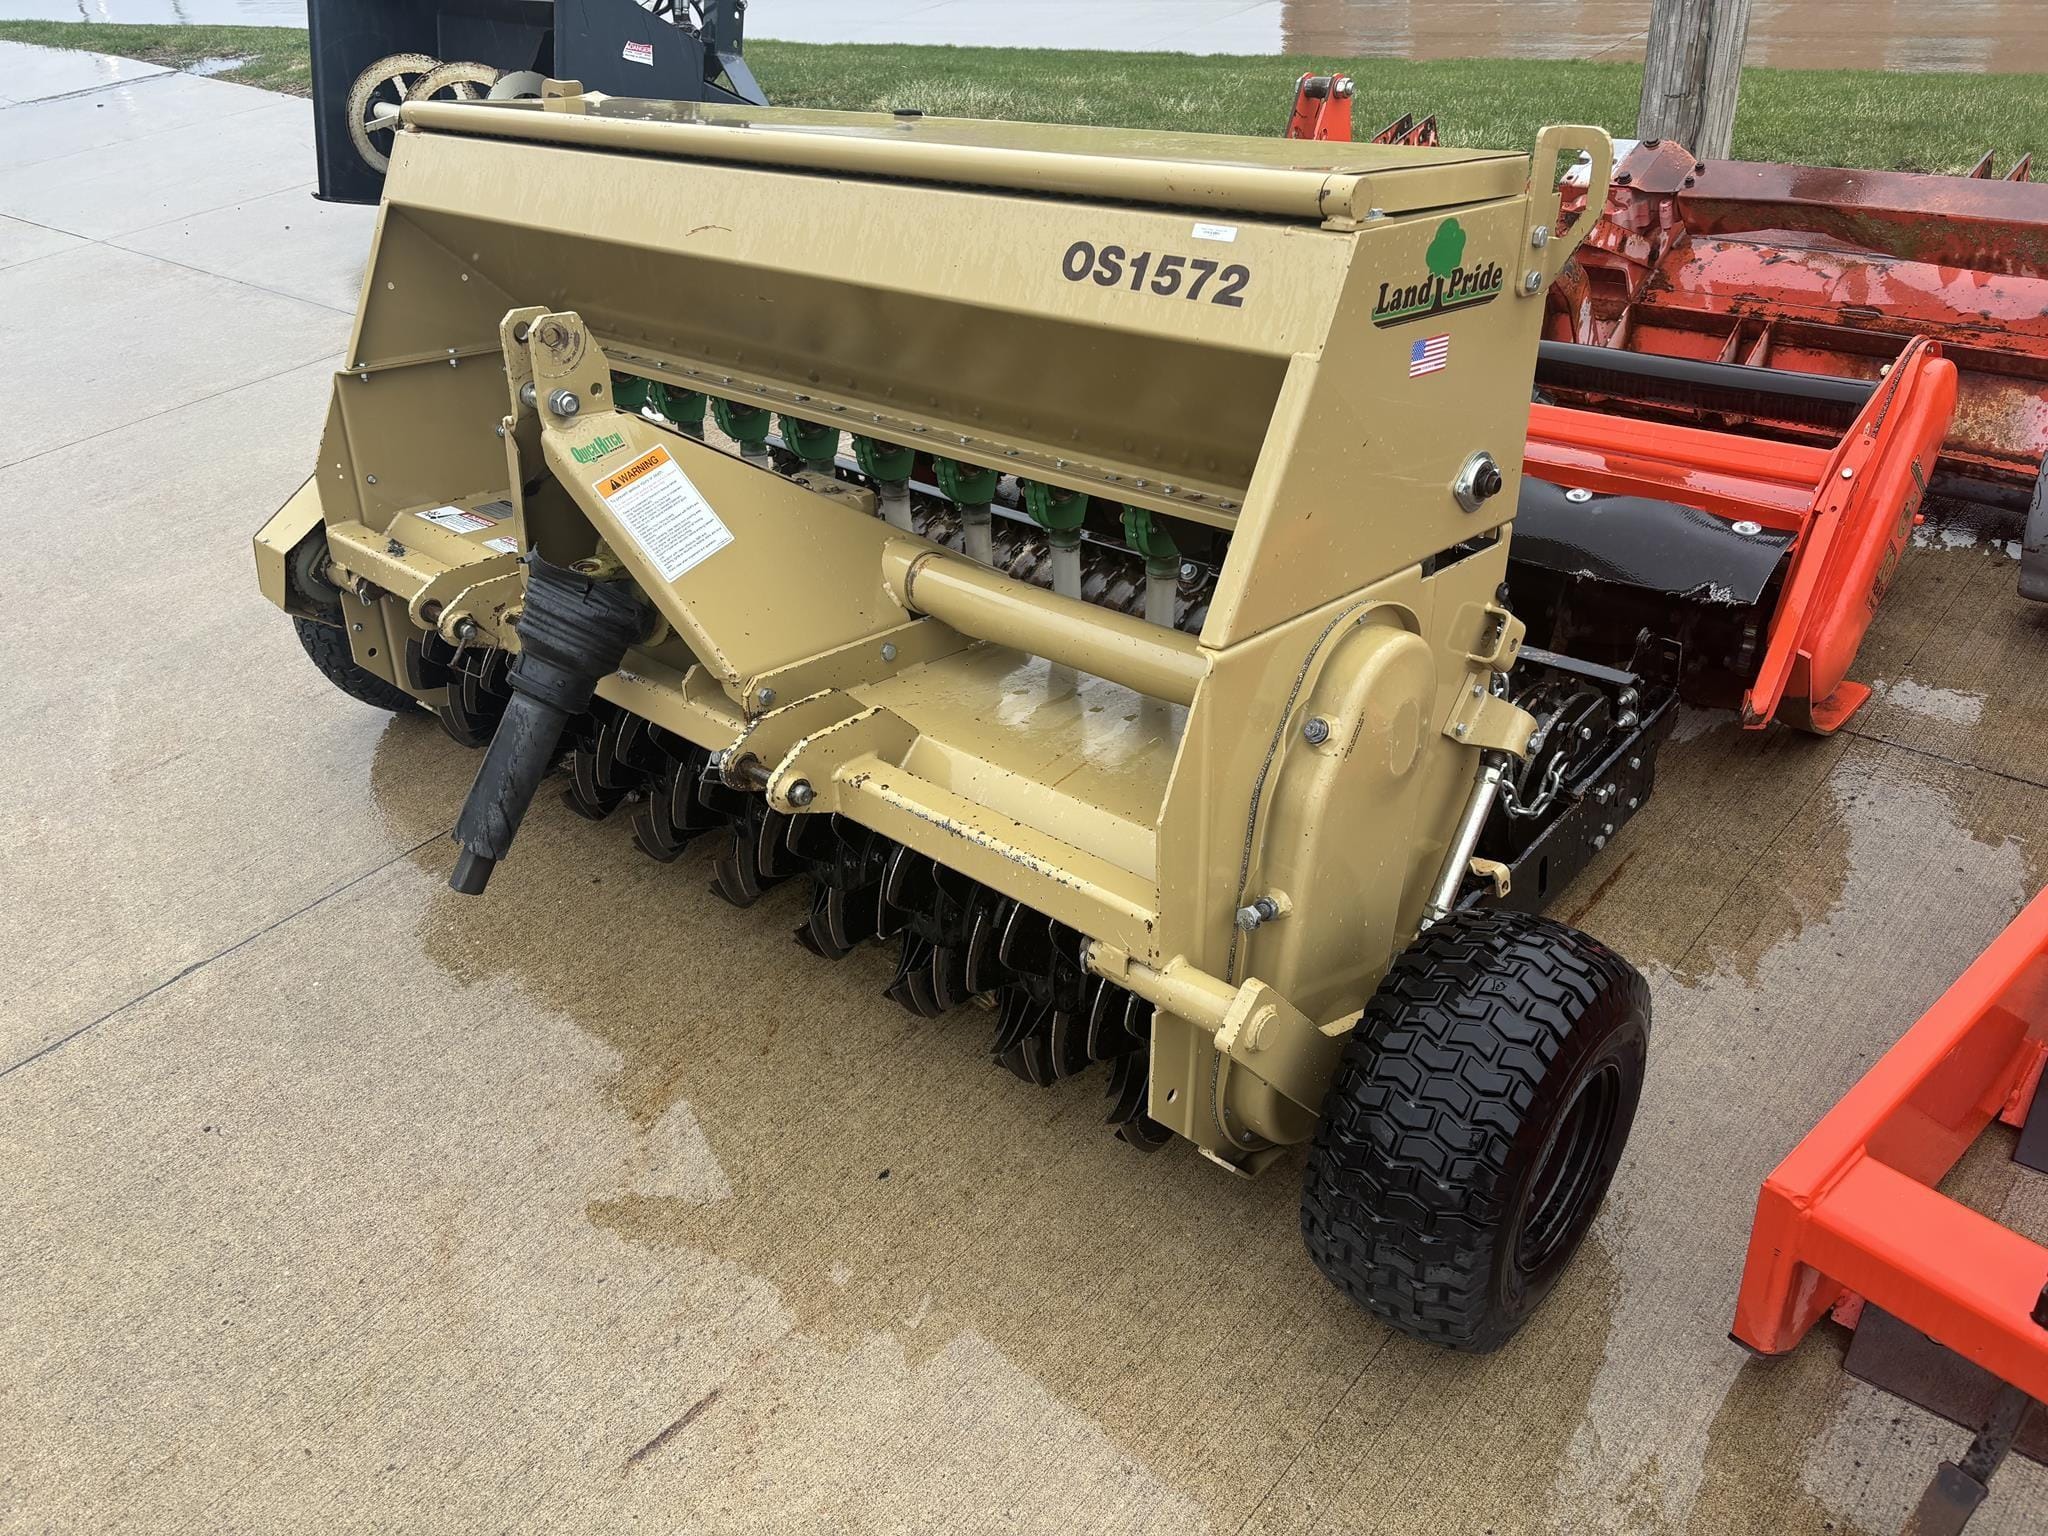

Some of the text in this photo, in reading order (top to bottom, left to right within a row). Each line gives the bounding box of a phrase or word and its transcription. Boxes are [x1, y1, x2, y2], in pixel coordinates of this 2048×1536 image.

[1062, 240, 1250, 308] OS1572
[1375, 261, 1503, 314] Land Pride
[618, 455, 659, 483] WARNING
